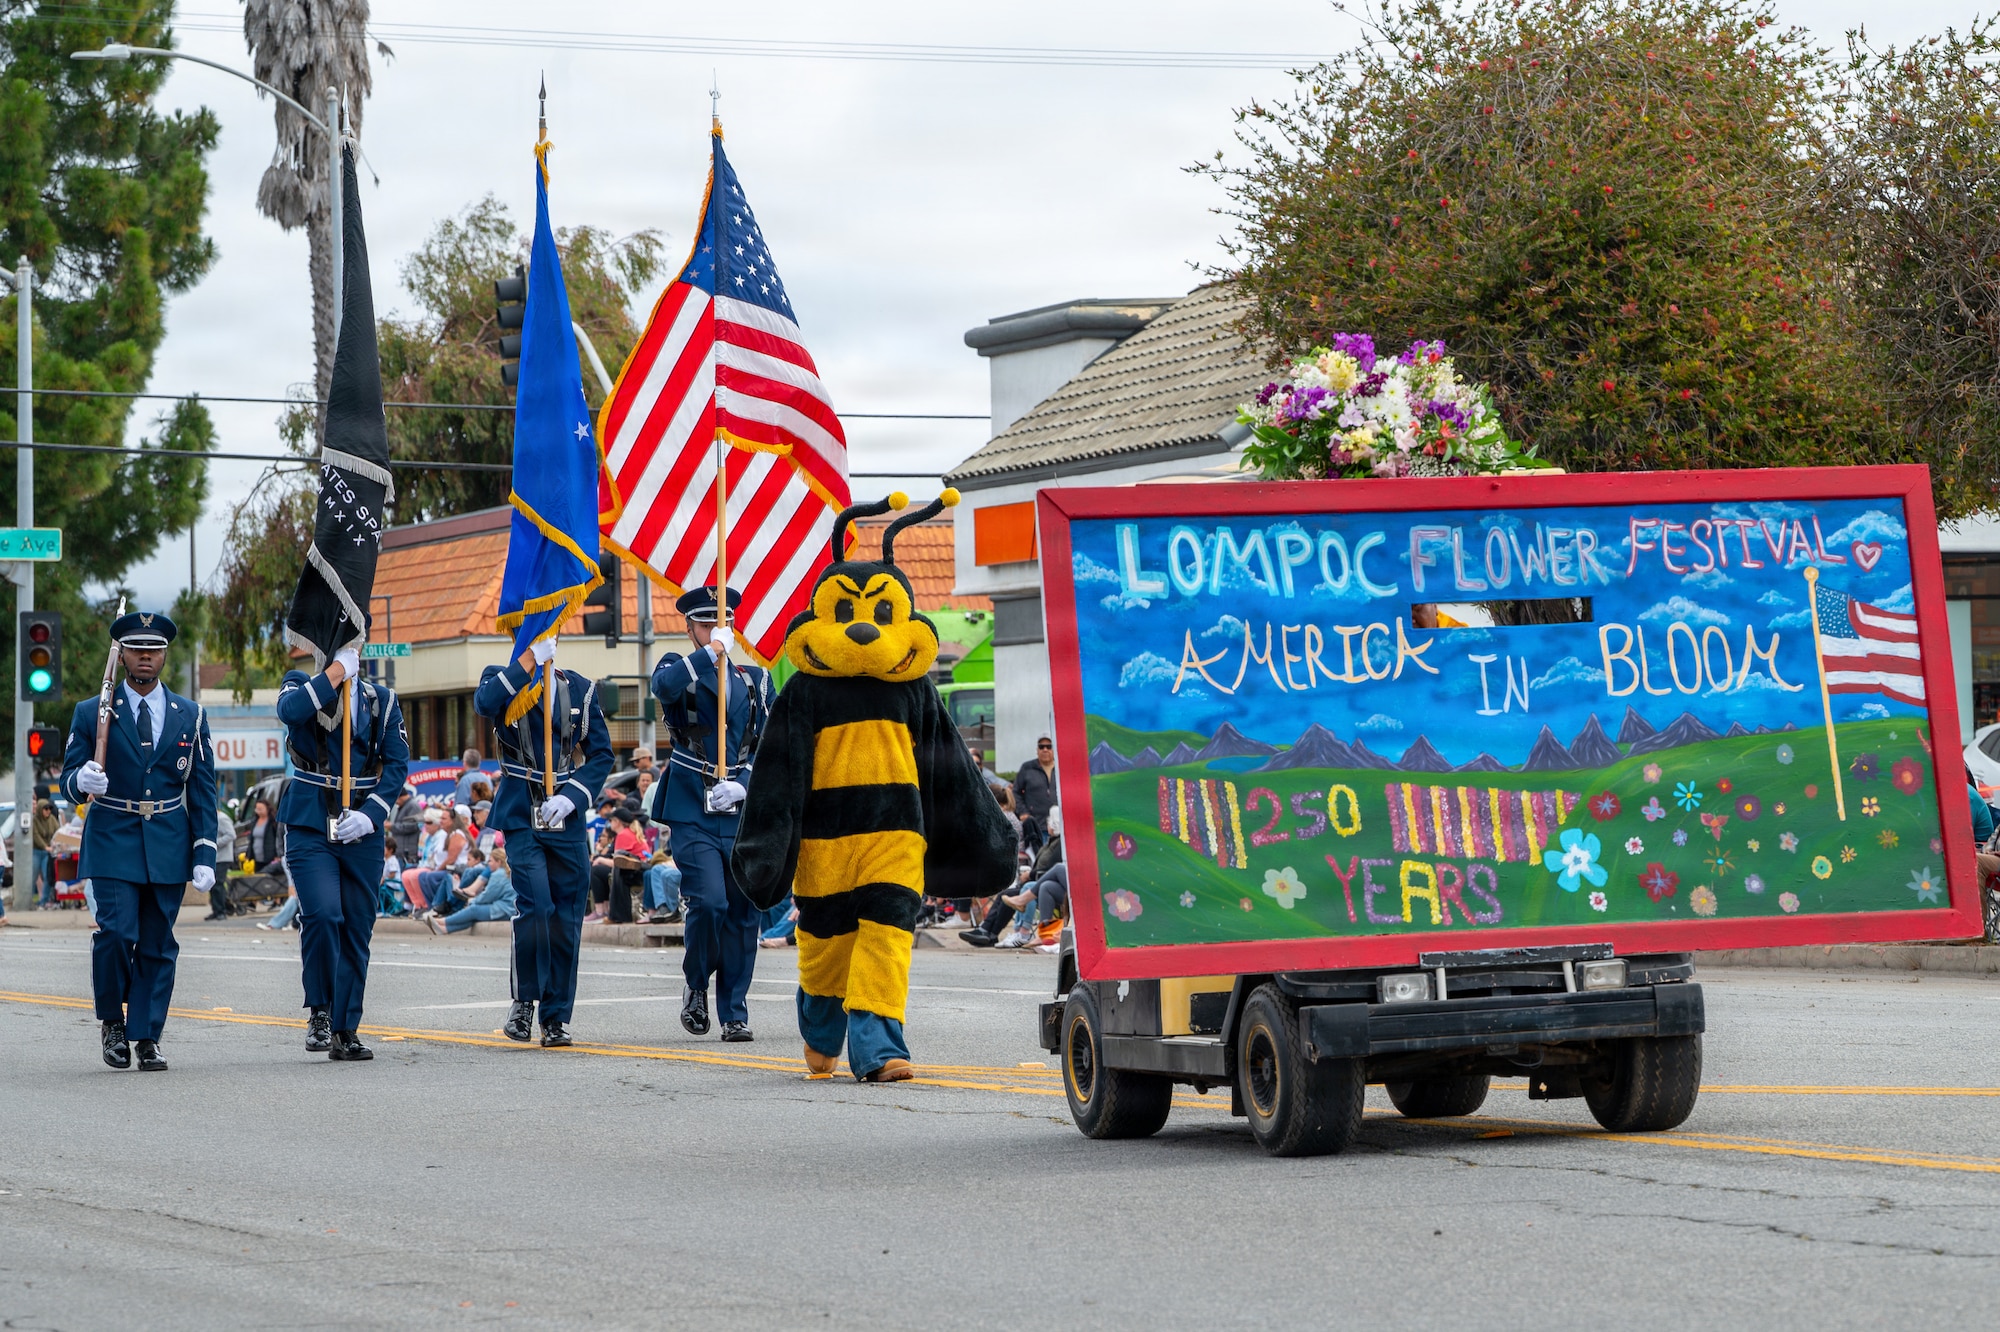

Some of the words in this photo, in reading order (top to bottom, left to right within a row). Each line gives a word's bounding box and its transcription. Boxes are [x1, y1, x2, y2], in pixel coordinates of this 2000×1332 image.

[321, 464, 356, 504] ATES
[356, 506, 382, 543] SPA
[20, 536, 56, 552] Ave
[1115, 524, 1399, 599] LOMPOC
[1409, 522, 1610, 593] FLOWER
[1626, 514, 1848, 577] FESTIVAL
[364, 644, 399, 657] COLLEGE
[1171, 616, 1440, 695] AMERICA
[1467, 653, 1530, 716] IN
[1599, 621, 1804, 697] BLOOM
[217, 738, 279, 762] QUR
[410, 770, 439, 785] SUSHI
[1246, 784, 1362, 848] 250
[1324, 853, 1504, 927] YEARS
